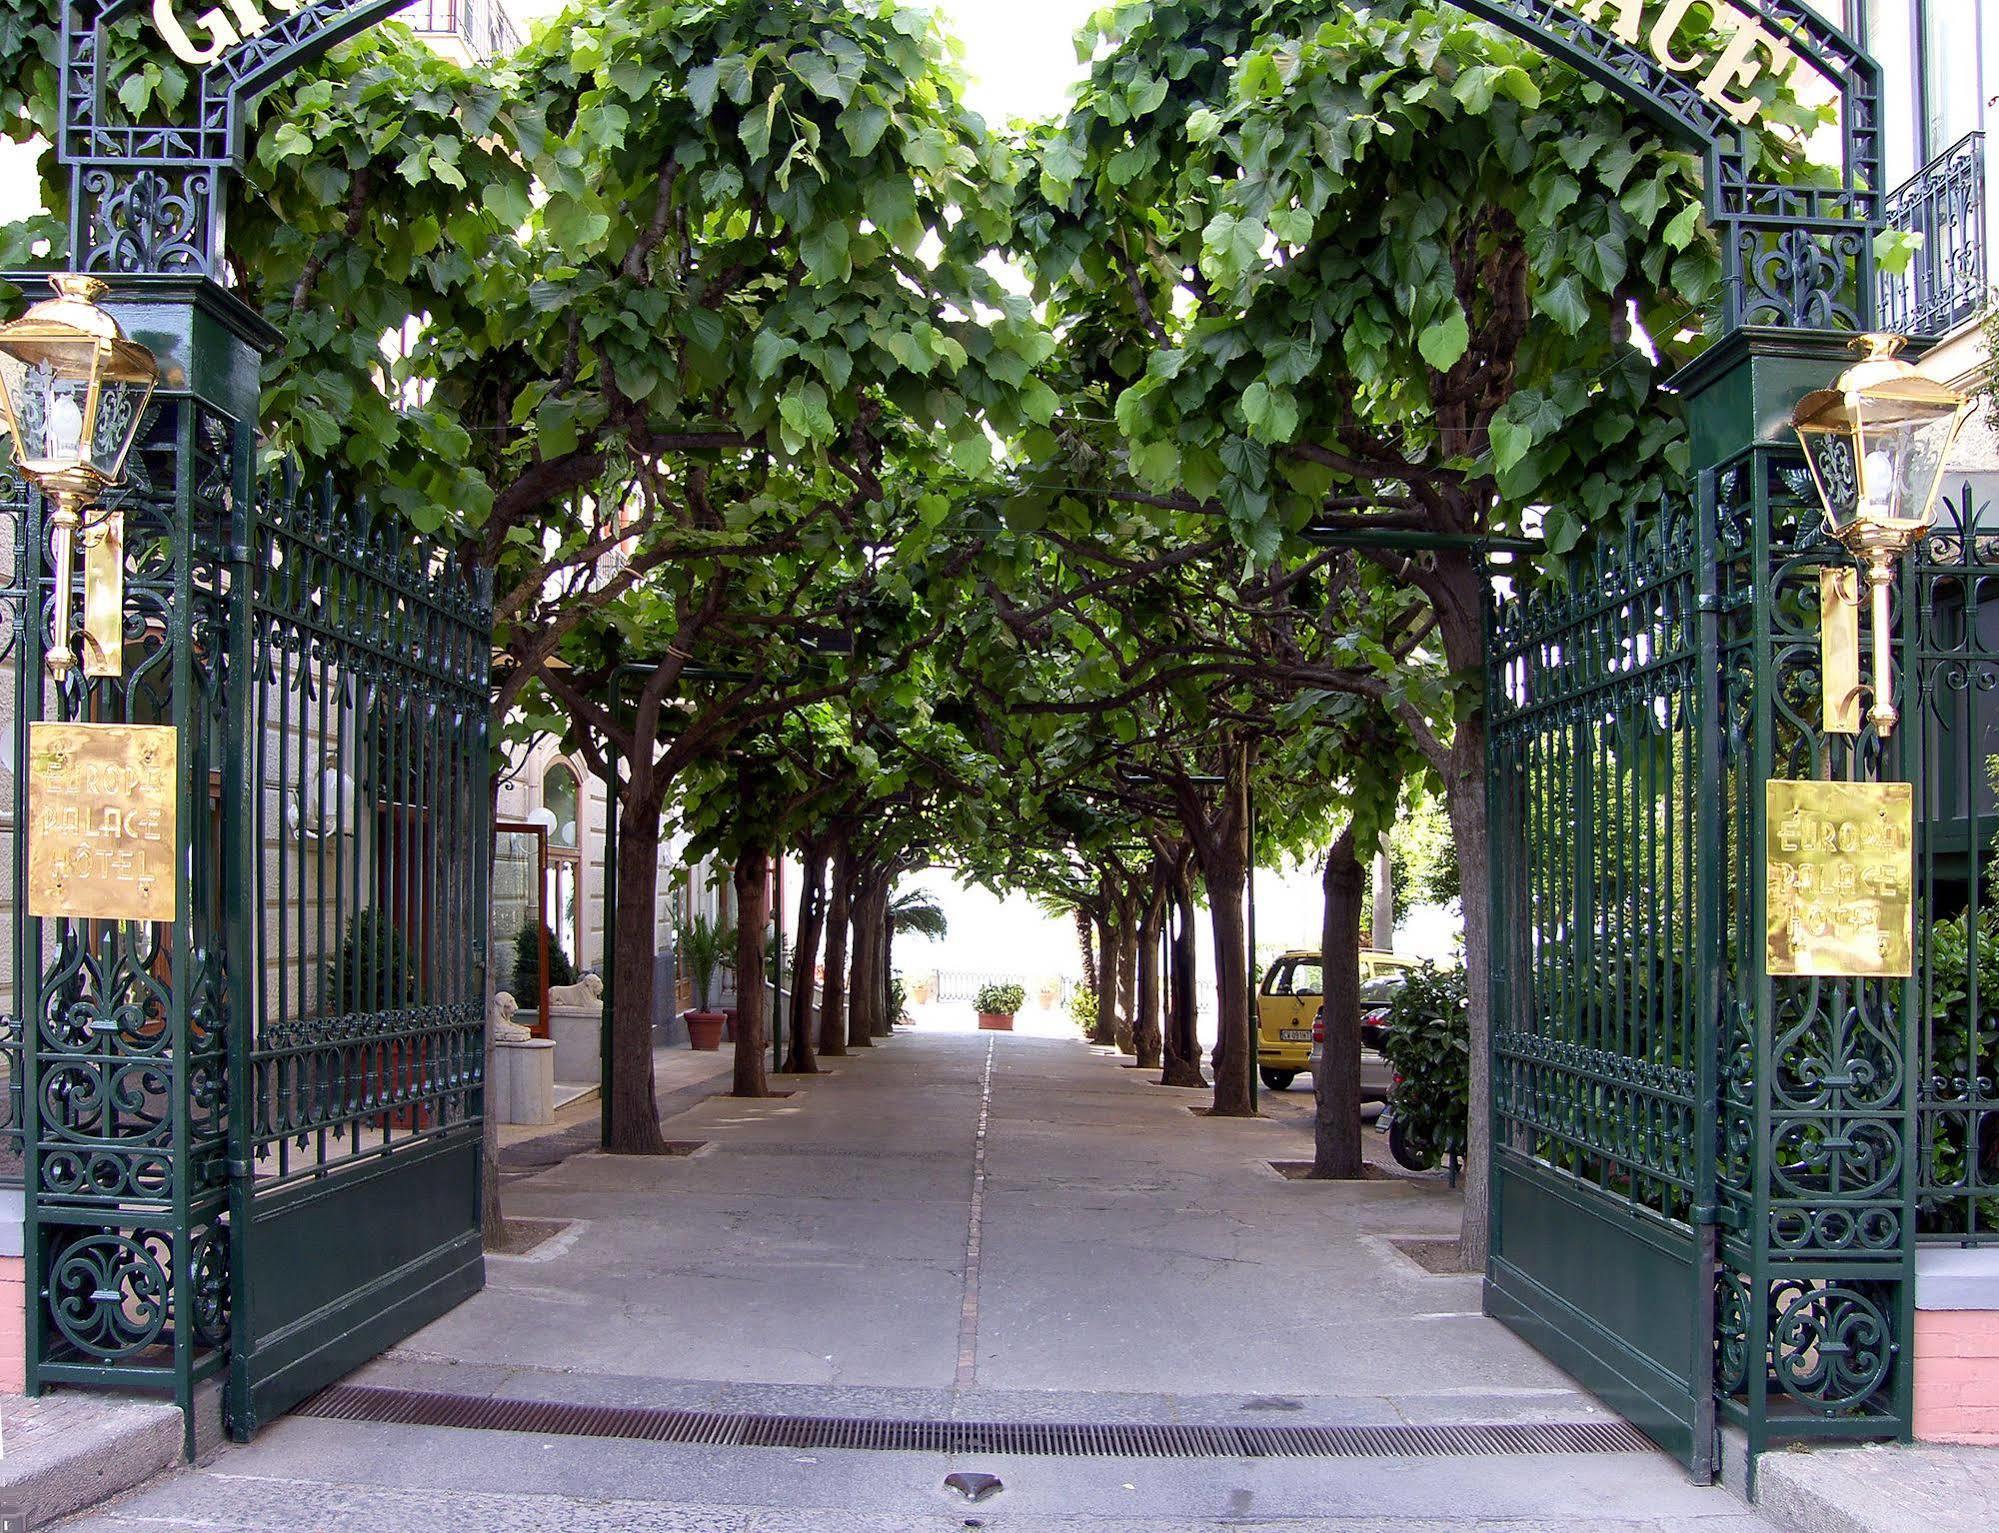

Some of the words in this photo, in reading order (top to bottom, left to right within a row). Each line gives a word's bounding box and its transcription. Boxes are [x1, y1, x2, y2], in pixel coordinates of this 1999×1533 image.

[153, 0, 298, 66] G
[43, 806, 161, 840] PALACE
[1778, 863, 1897, 896] PALACE
